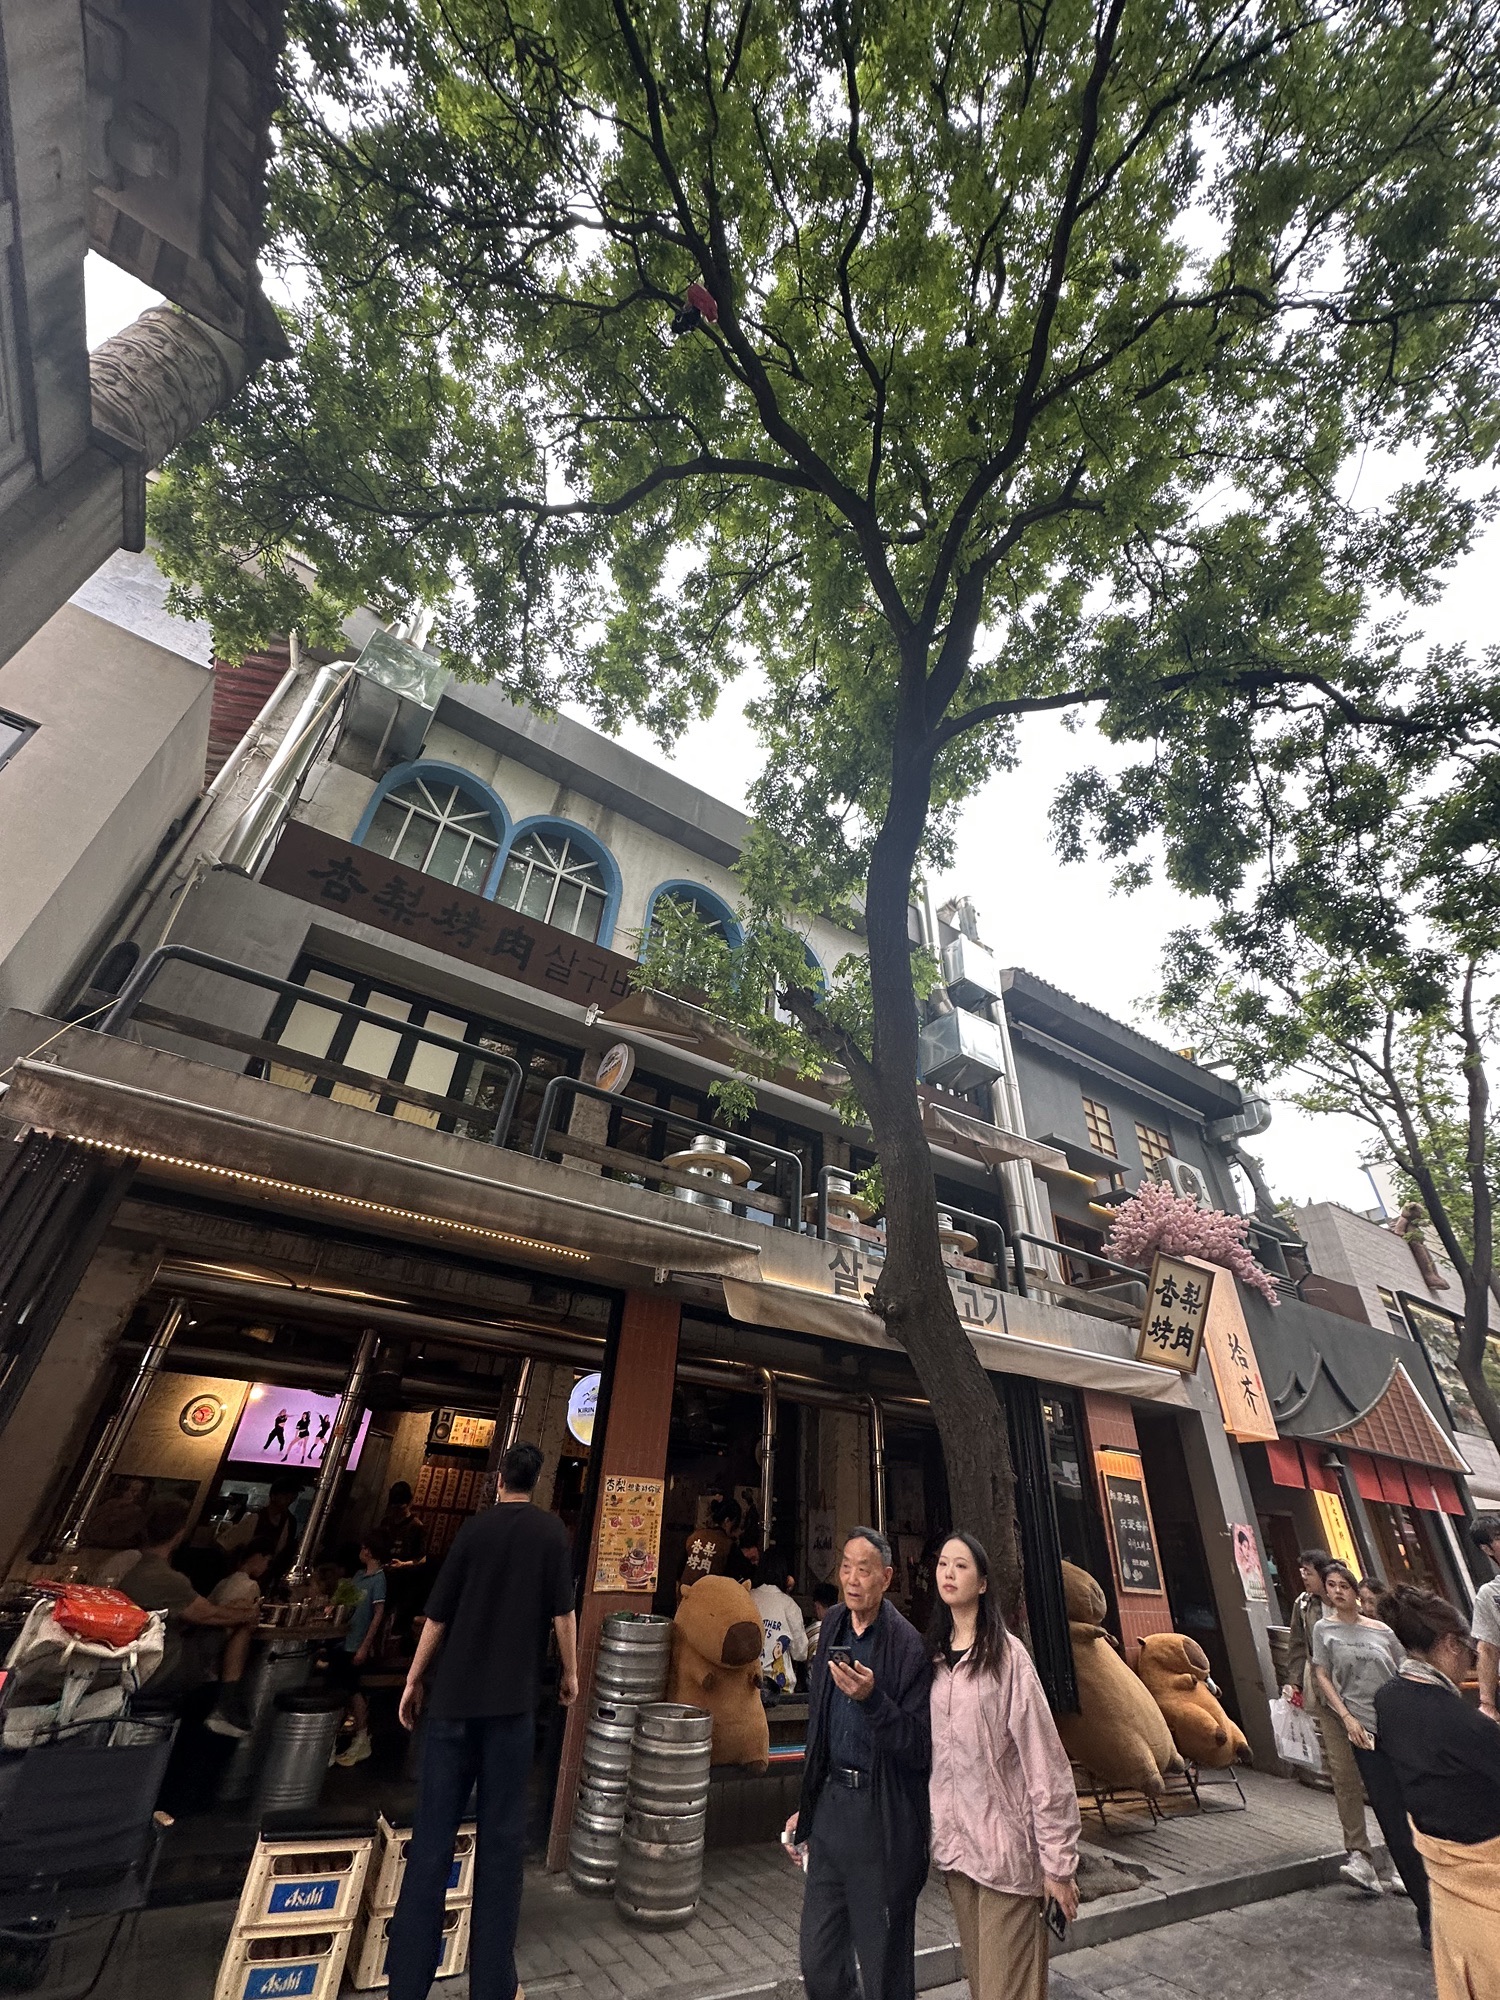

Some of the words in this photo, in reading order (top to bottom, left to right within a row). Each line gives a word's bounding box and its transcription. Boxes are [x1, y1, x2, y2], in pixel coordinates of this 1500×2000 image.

[307, 856, 536, 971] 杏梨烤肉
[1155, 1274, 1204, 1315] 杏梨
[1147, 1314, 1195, 1357] 烤肉
[577, 1406, 595, 1414] KIRIN
[606, 1477, 627, 1493] 杏梨
[691, 1539, 717, 1557] 杏梨
[686, 1554, 712, 1574] 烤肉
[284, 1886, 325, 1908] Asahi
[260, 1970, 303, 1995] Asahi
